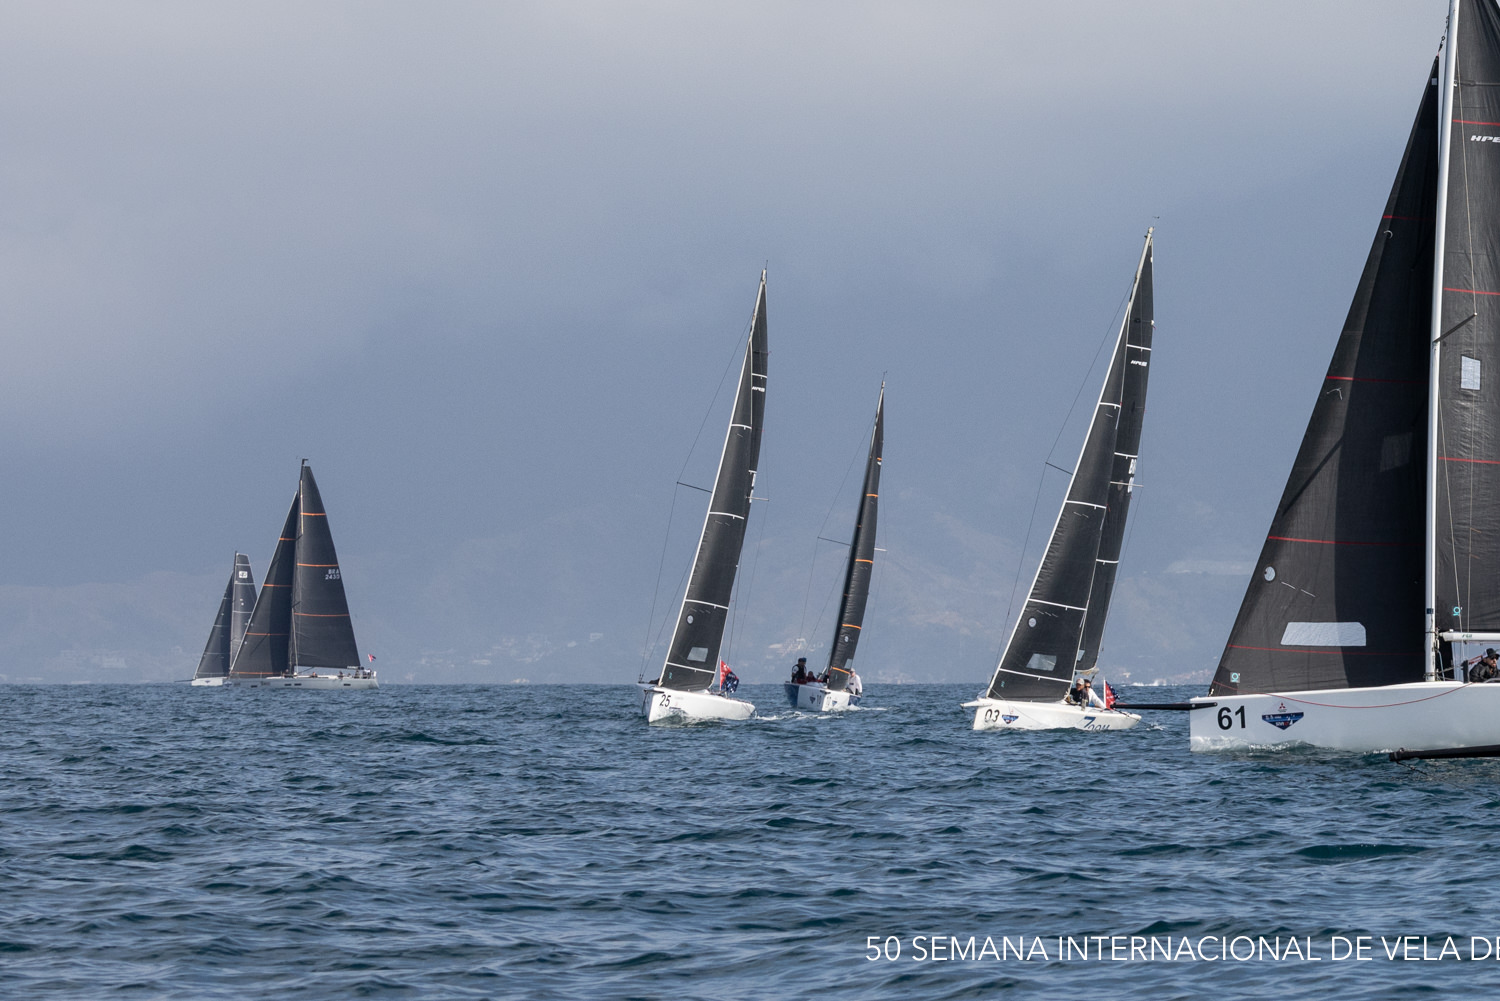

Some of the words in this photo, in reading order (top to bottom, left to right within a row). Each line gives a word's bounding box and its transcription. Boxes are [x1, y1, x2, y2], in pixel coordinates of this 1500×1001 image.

[659, 694, 672, 708] 25
[984, 708, 1001, 723] 03
[1217, 705, 1246, 731] 61
